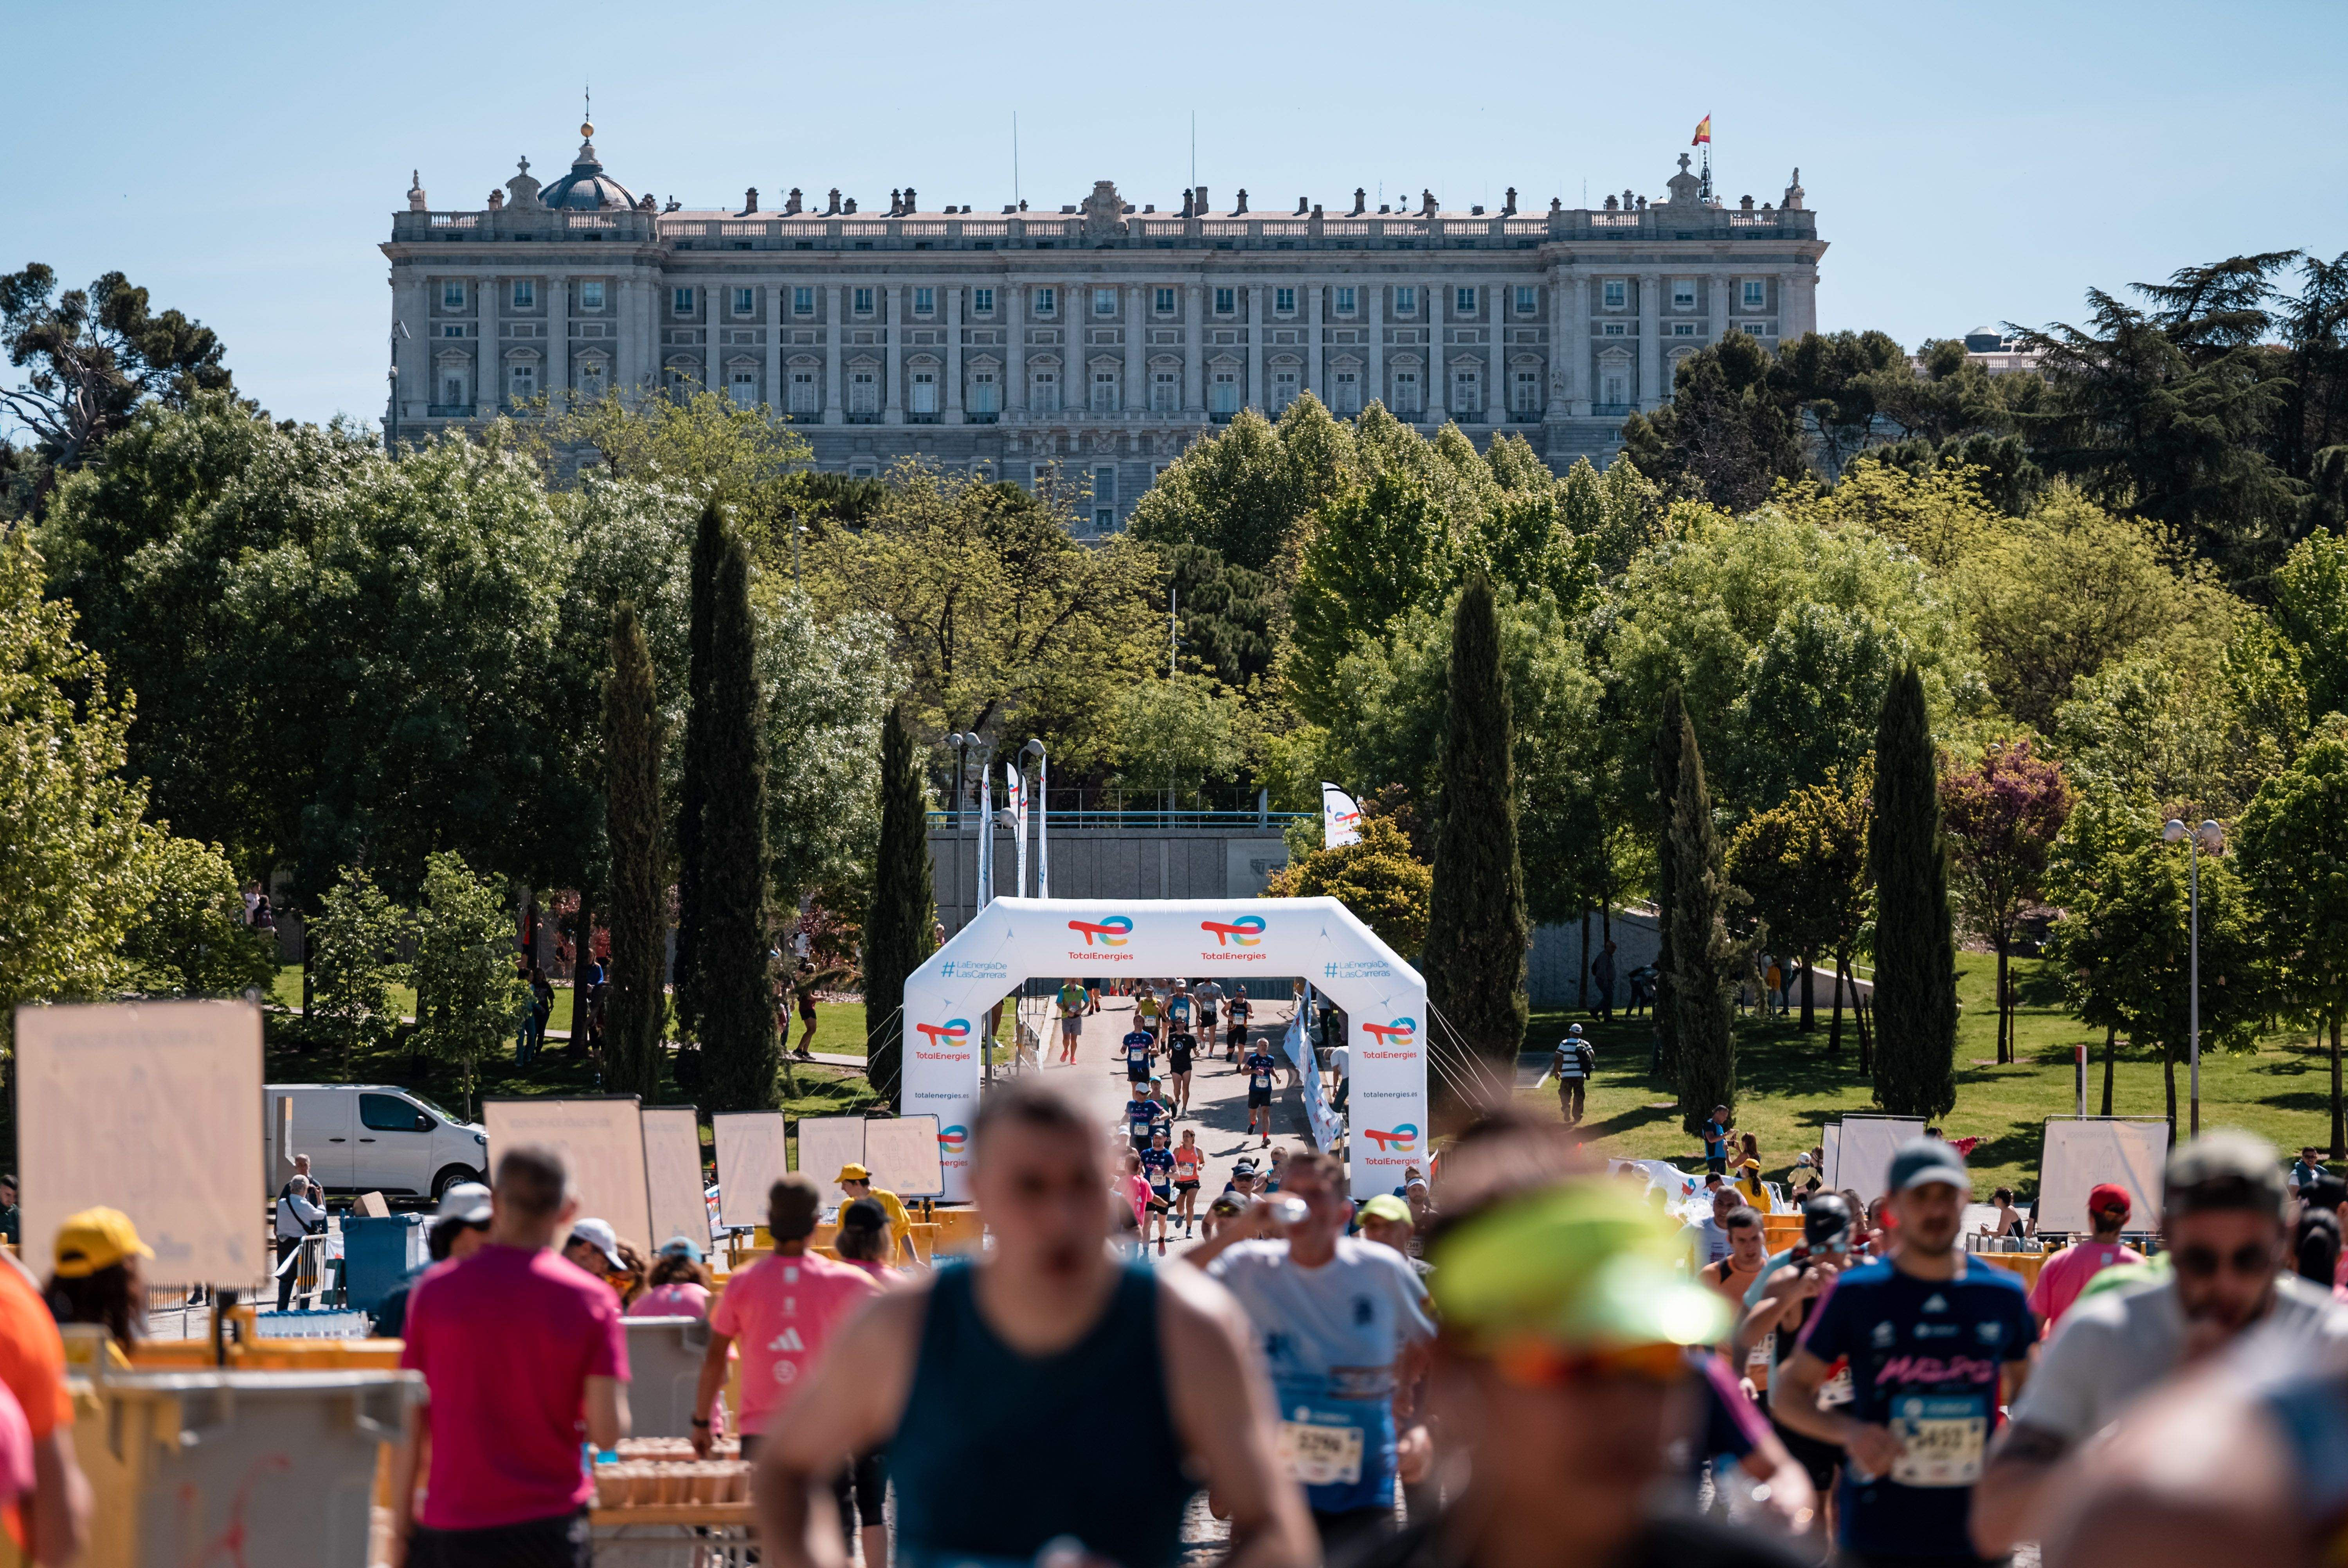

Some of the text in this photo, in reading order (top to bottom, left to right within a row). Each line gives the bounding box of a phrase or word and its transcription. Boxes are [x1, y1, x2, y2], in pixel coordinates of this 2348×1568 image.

[1068, 951, 1133, 962] TotalEnergies
[1201, 952, 1266, 961] TotalEnergies
[956, 970, 1007, 978] LasCarreras
[1340, 969, 1390, 978] LasCarreras
[916, 1052, 970, 1061] TotalEnergies
[1363, 1051, 1417, 1060] TotalEnergies
[1363, 1090, 1418, 1099] totalenergies.es
[939, 1159, 968, 1168] nergies
[1365, 1157, 1419, 1166] TotalEnergies
